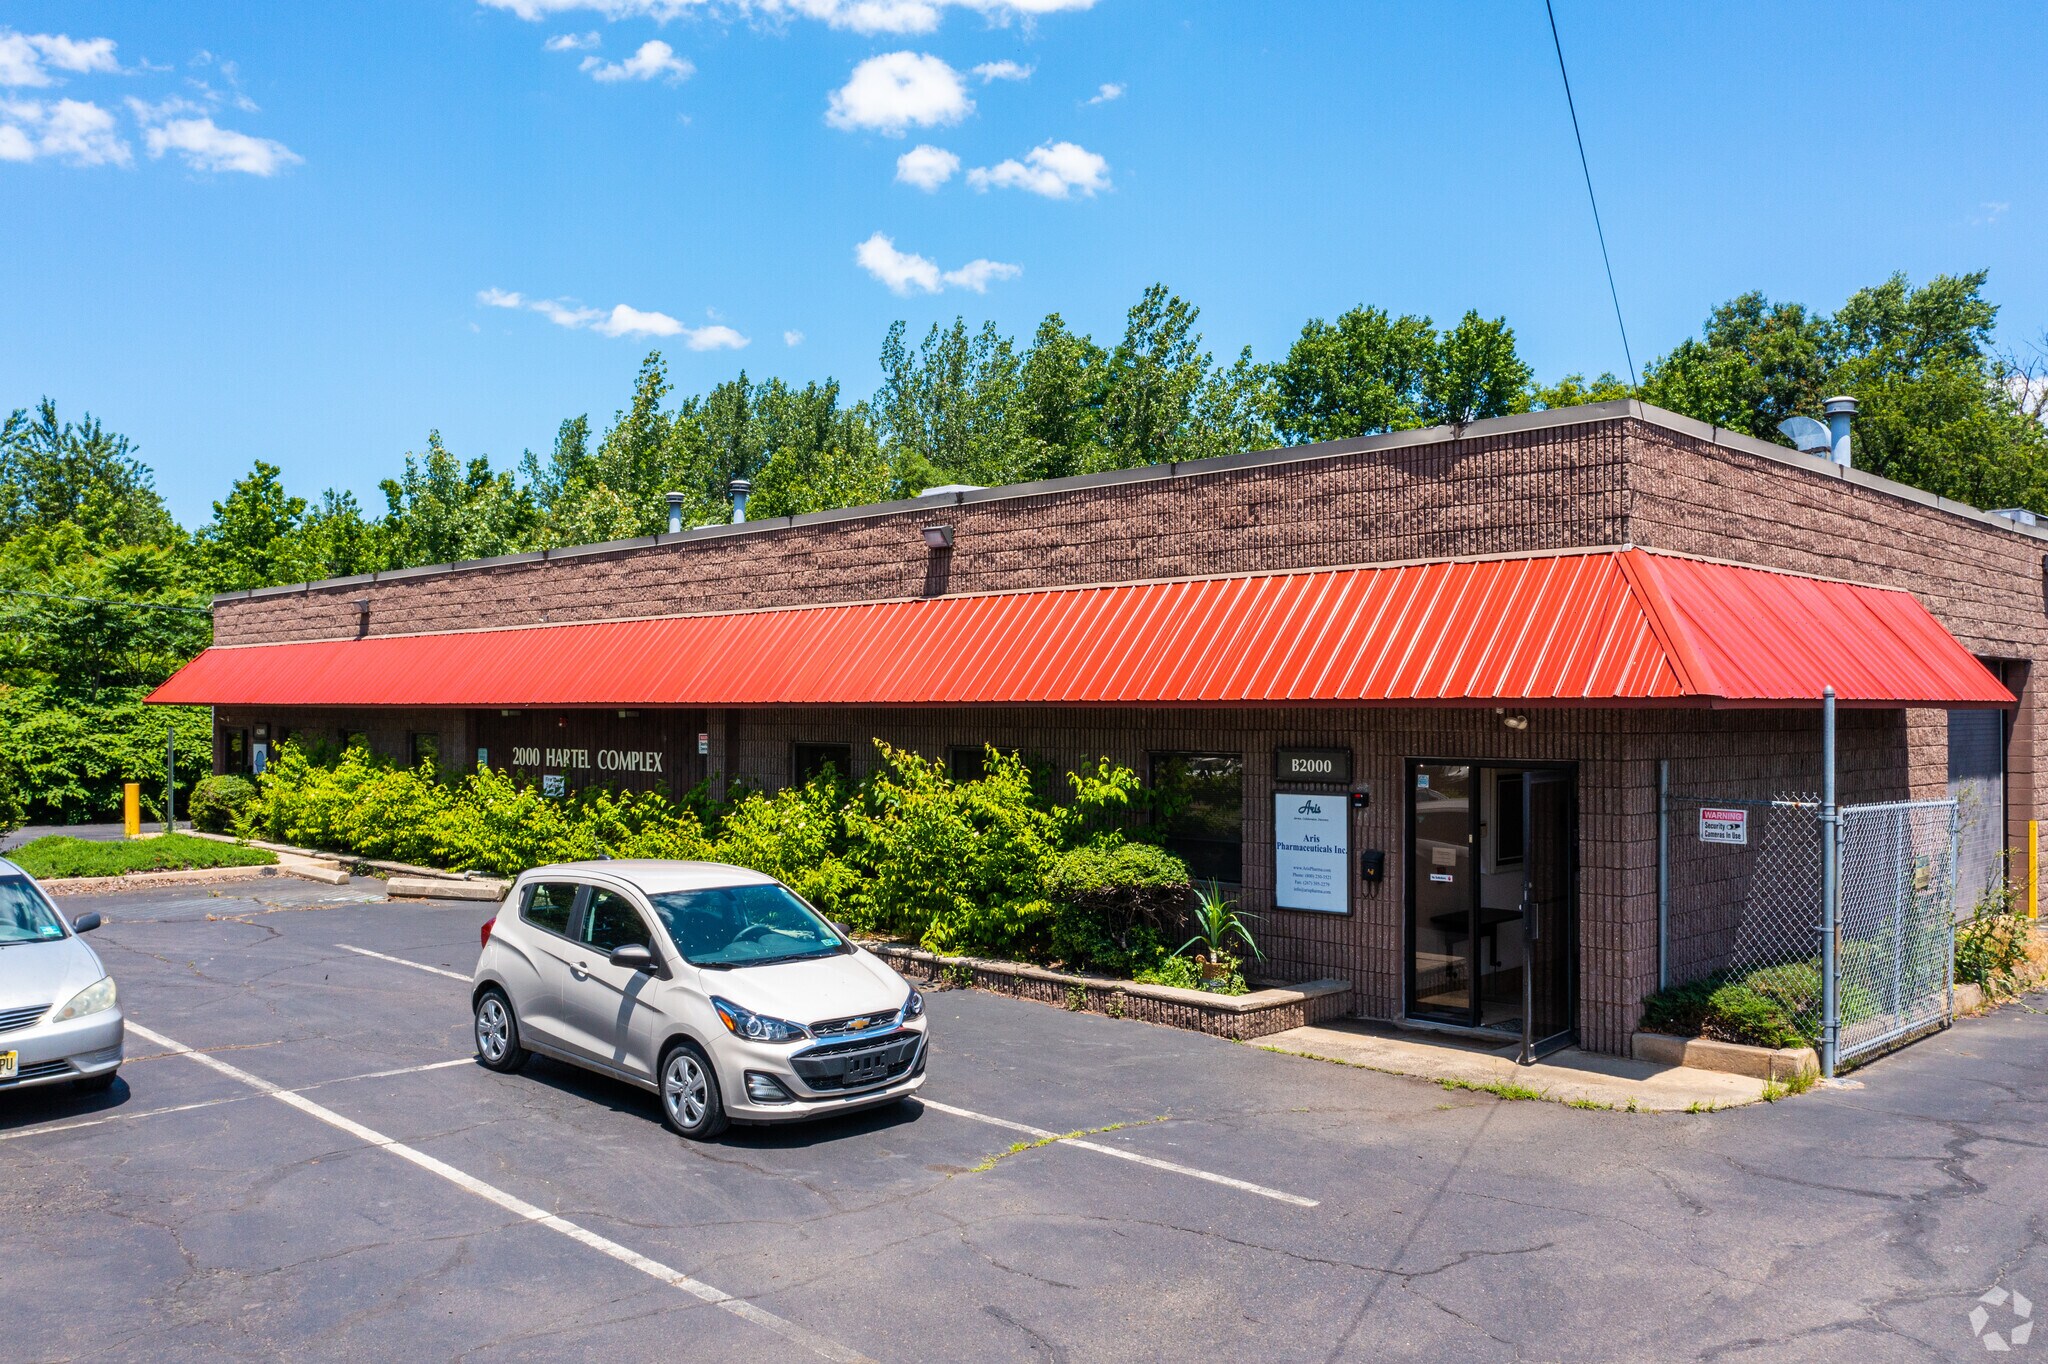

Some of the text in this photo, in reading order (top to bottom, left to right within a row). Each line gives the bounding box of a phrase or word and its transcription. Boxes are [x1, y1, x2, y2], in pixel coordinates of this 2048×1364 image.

[512, 747, 663, 773] 2000 HARTEL COMPLEX
[1291, 758, 1332, 773] B2000
[1298, 799, 1322, 815] Aris
[1704, 810, 1742, 821] WARNING
[1704, 821, 1725, 831] Security
[1303, 834, 1320, 843] Aris
[1704, 830, 1725, 839] Cameras
[1276, 842, 1348, 855] Pharmaceuticals Inc.
